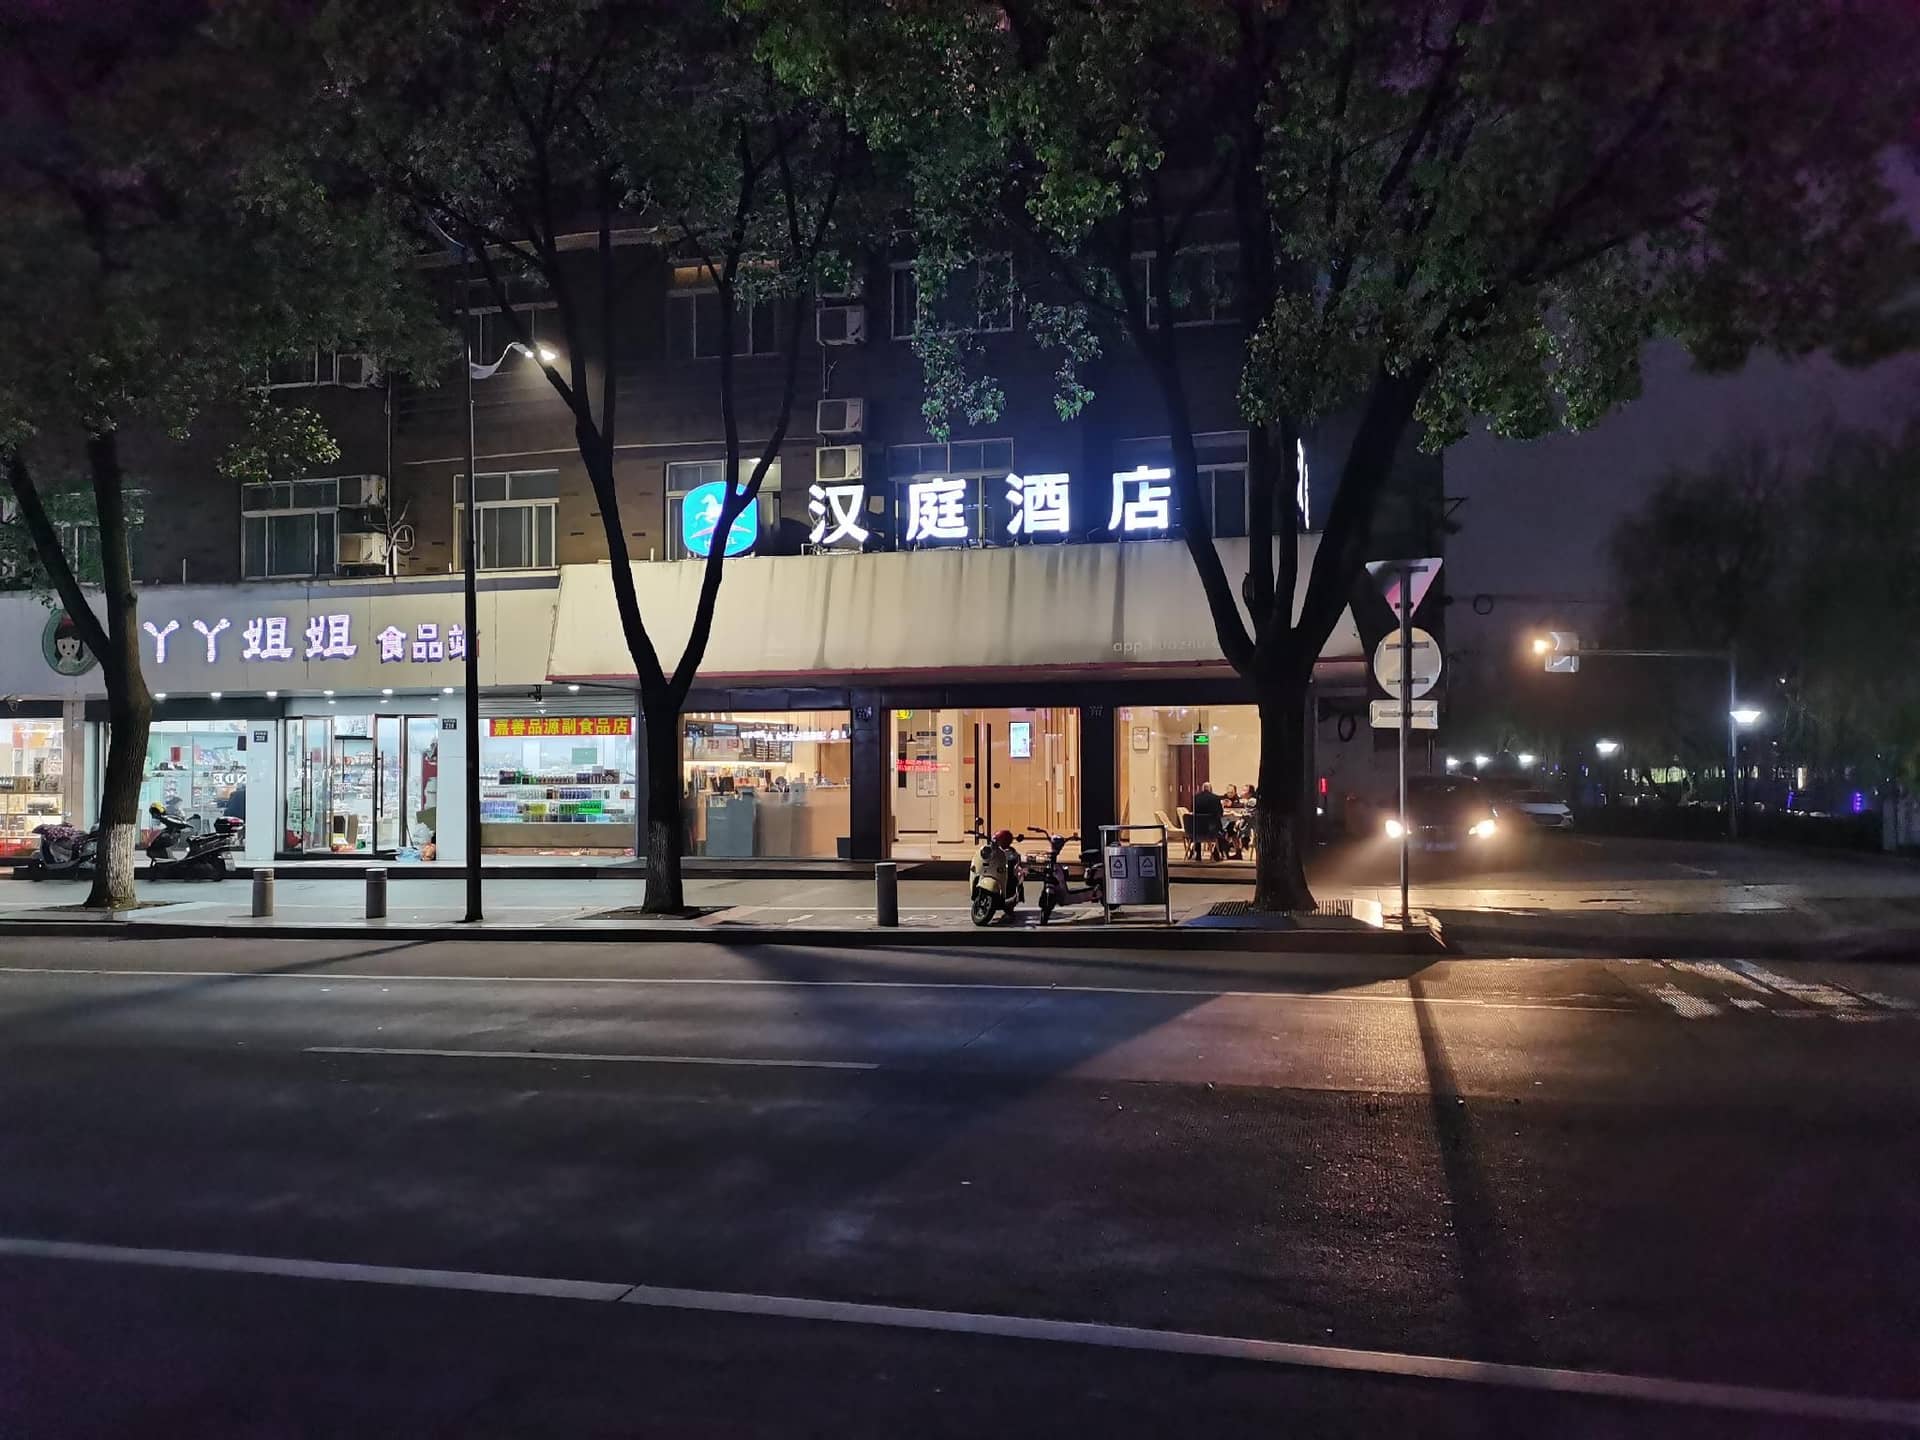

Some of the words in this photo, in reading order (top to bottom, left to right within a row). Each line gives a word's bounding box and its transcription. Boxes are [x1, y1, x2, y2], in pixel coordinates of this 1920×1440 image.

[808, 465, 1173, 544] 汉庭酒店
[494, 717, 628, 736] 嘉善品源副食品店
